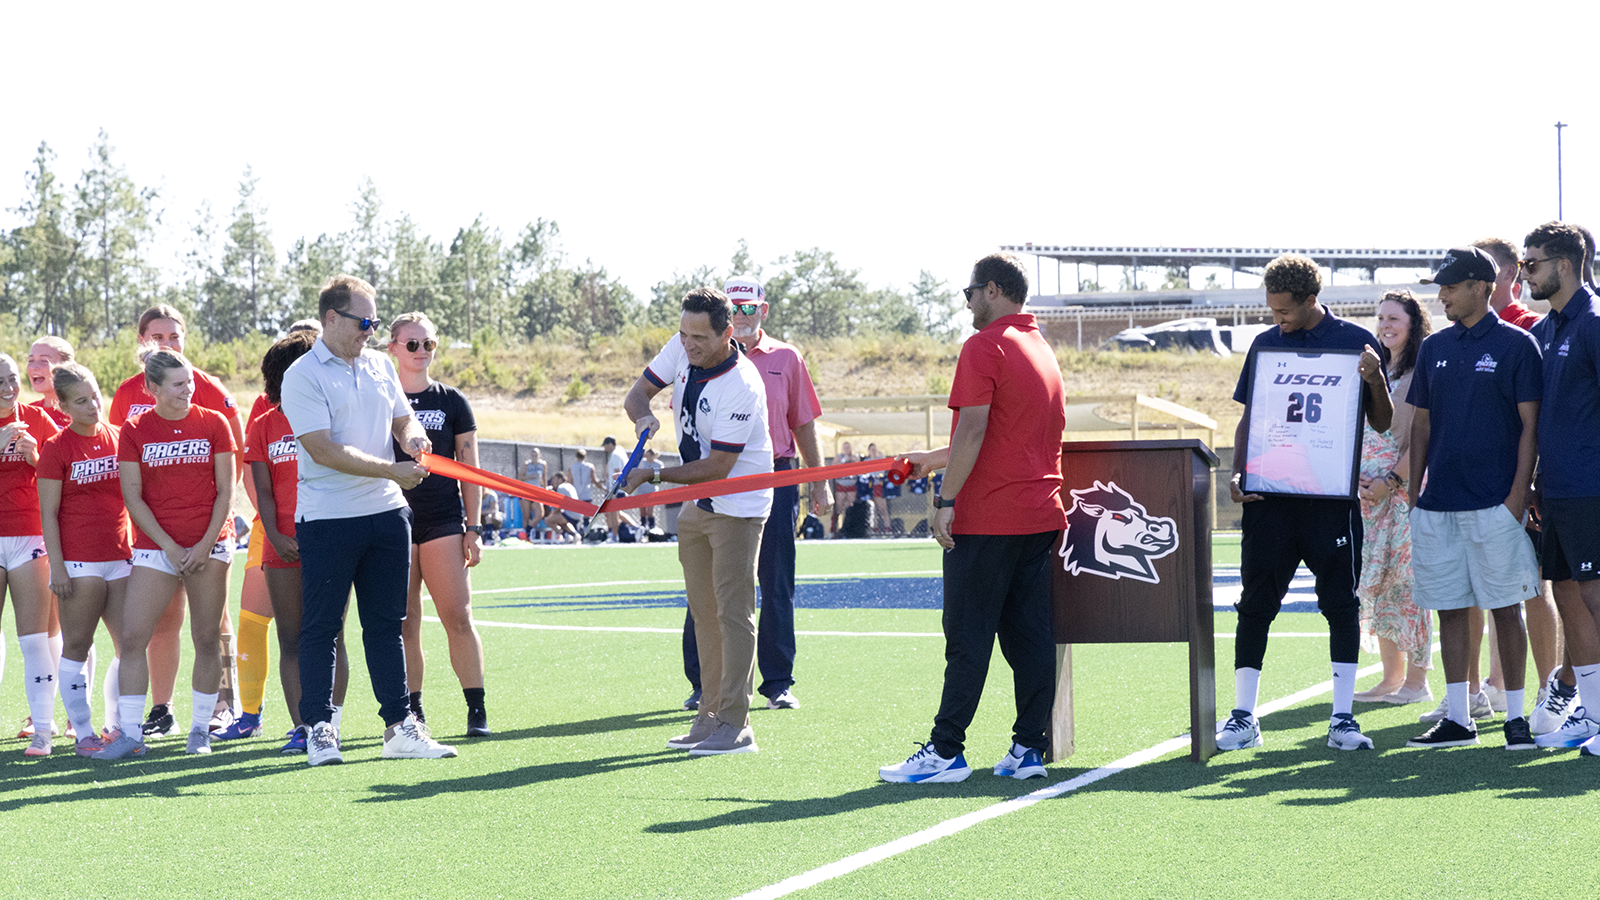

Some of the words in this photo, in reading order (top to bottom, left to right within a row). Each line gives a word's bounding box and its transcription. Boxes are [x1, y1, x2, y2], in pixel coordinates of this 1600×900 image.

[726, 286, 753, 294] USCA
[1273, 373, 1342, 387] USCA
[1286, 392, 1322, 423] 26
[414, 409, 446, 425] ERS
[730, 413, 751, 421] PBC
[142, 439, 211, 462] PACERS
[268, 440, 298, 461] PAC
[70, 455, 119, 480] PACE
[148, 458, 180, 467] WOMEN'S
[77, 473, 108, 485] WOMEN'S
